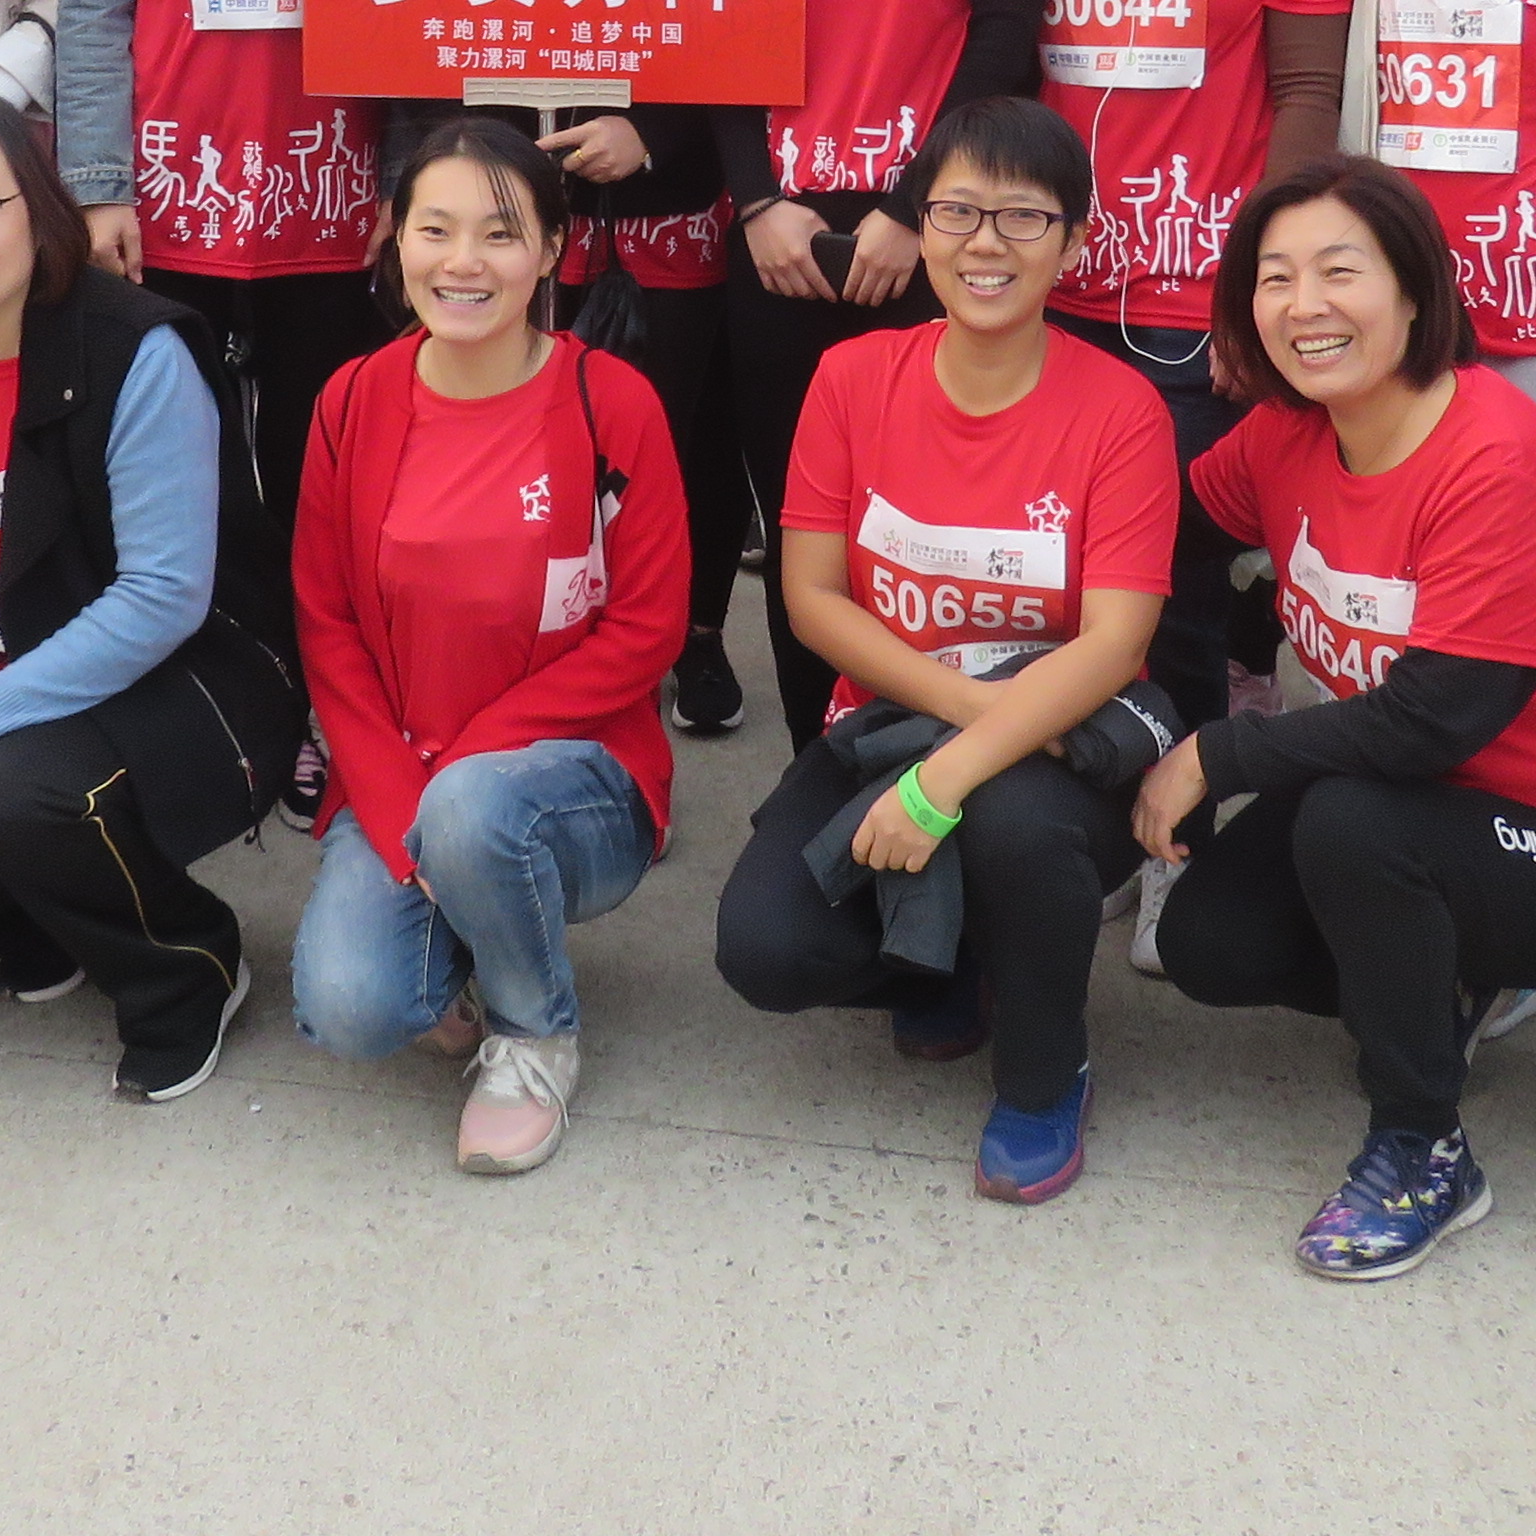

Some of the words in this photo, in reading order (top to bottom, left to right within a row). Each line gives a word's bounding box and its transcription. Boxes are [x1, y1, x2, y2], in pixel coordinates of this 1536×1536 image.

[437, 45, 527, 70] 聚力漯河
[872, 564, 1047, 633] 50655
